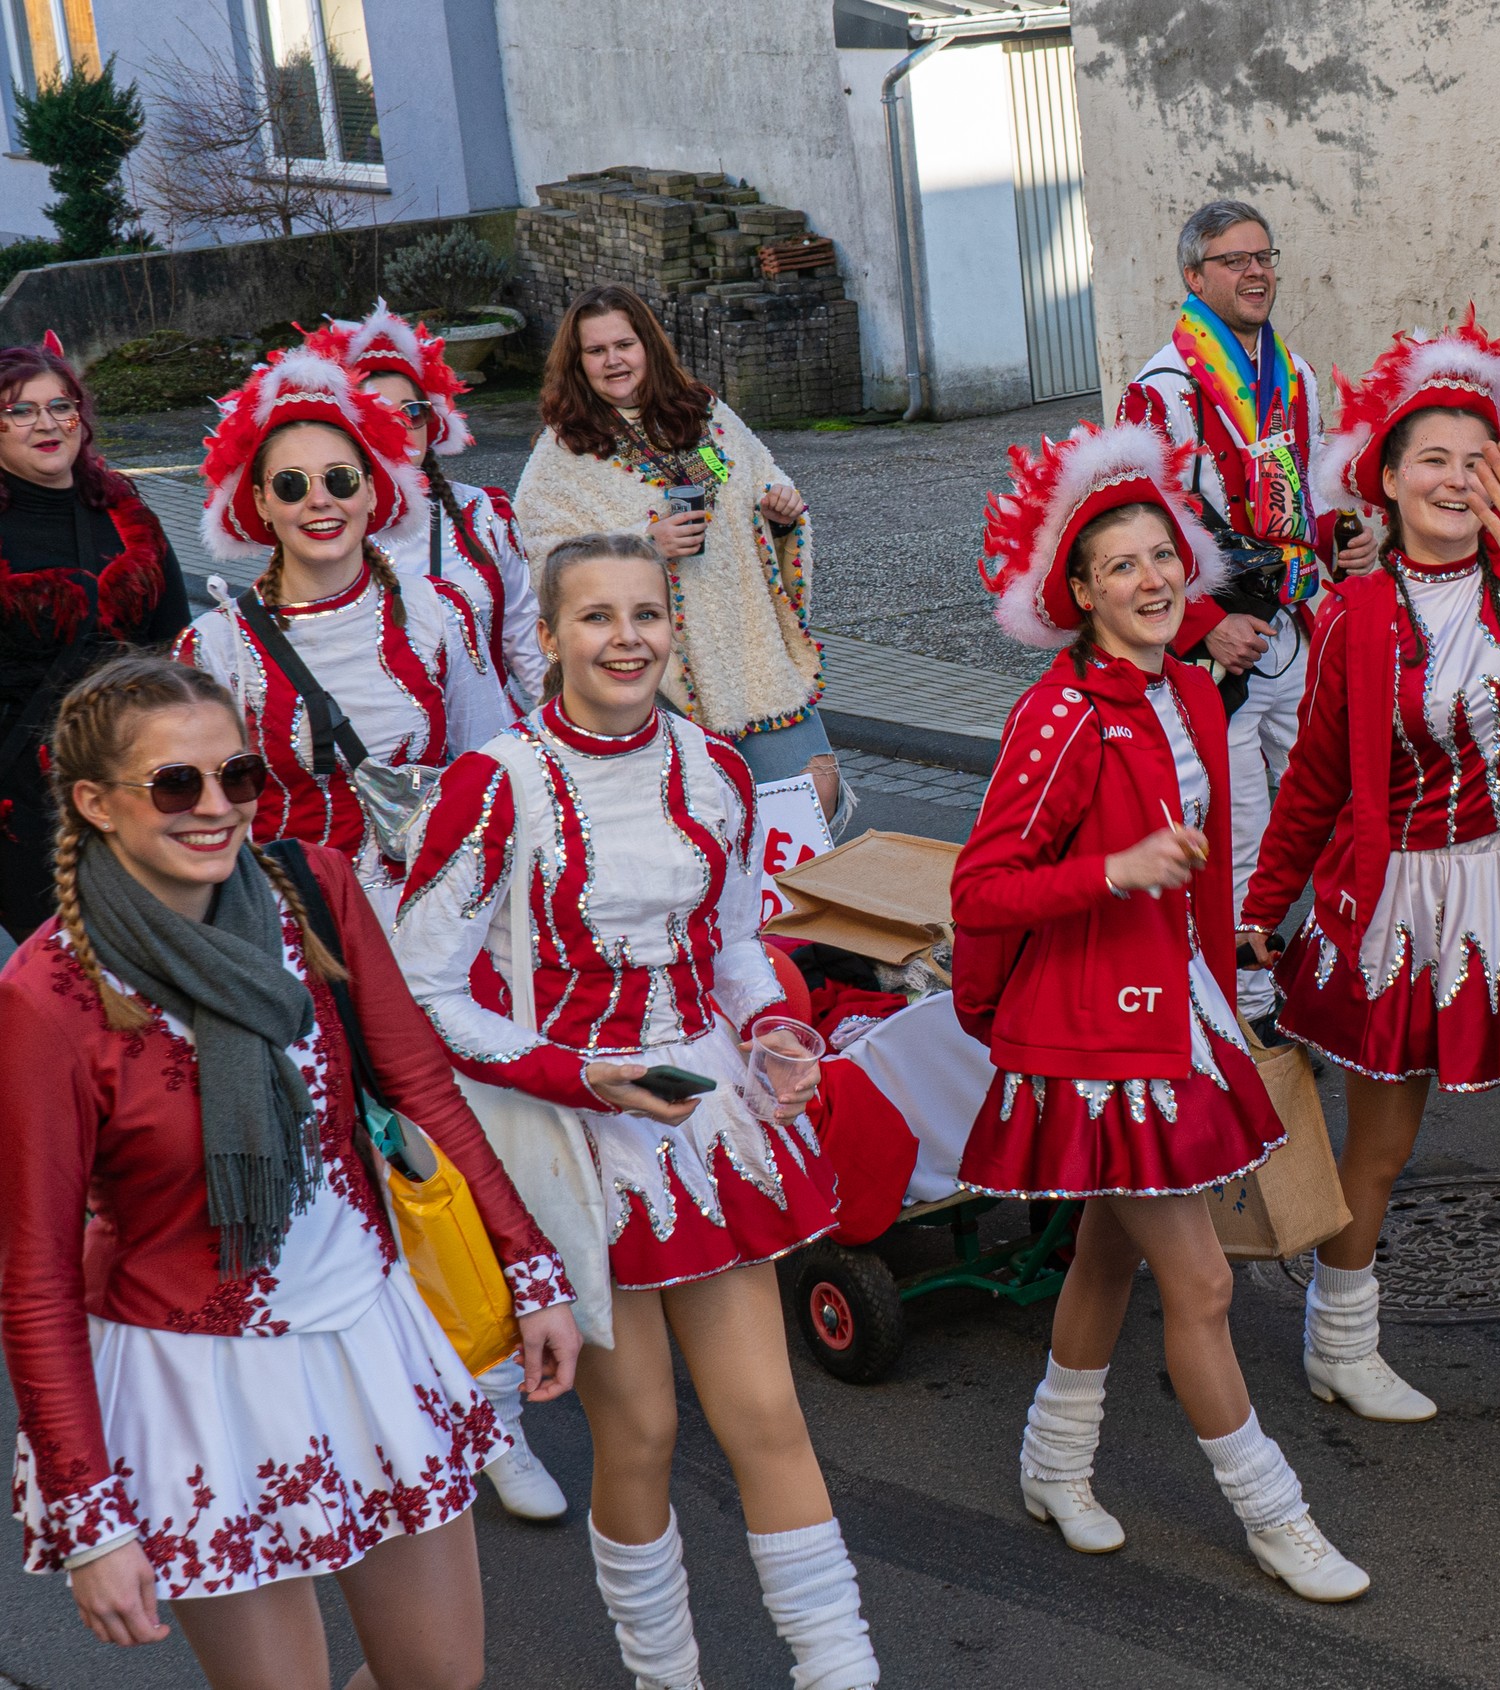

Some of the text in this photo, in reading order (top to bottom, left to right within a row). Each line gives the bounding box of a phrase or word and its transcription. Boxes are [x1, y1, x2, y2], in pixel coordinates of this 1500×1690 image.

[1269, 481, 1287, 514] 200
[1103, 725, 1133, 740] JAKO
[1117, 986, 1163, 1013] CT
